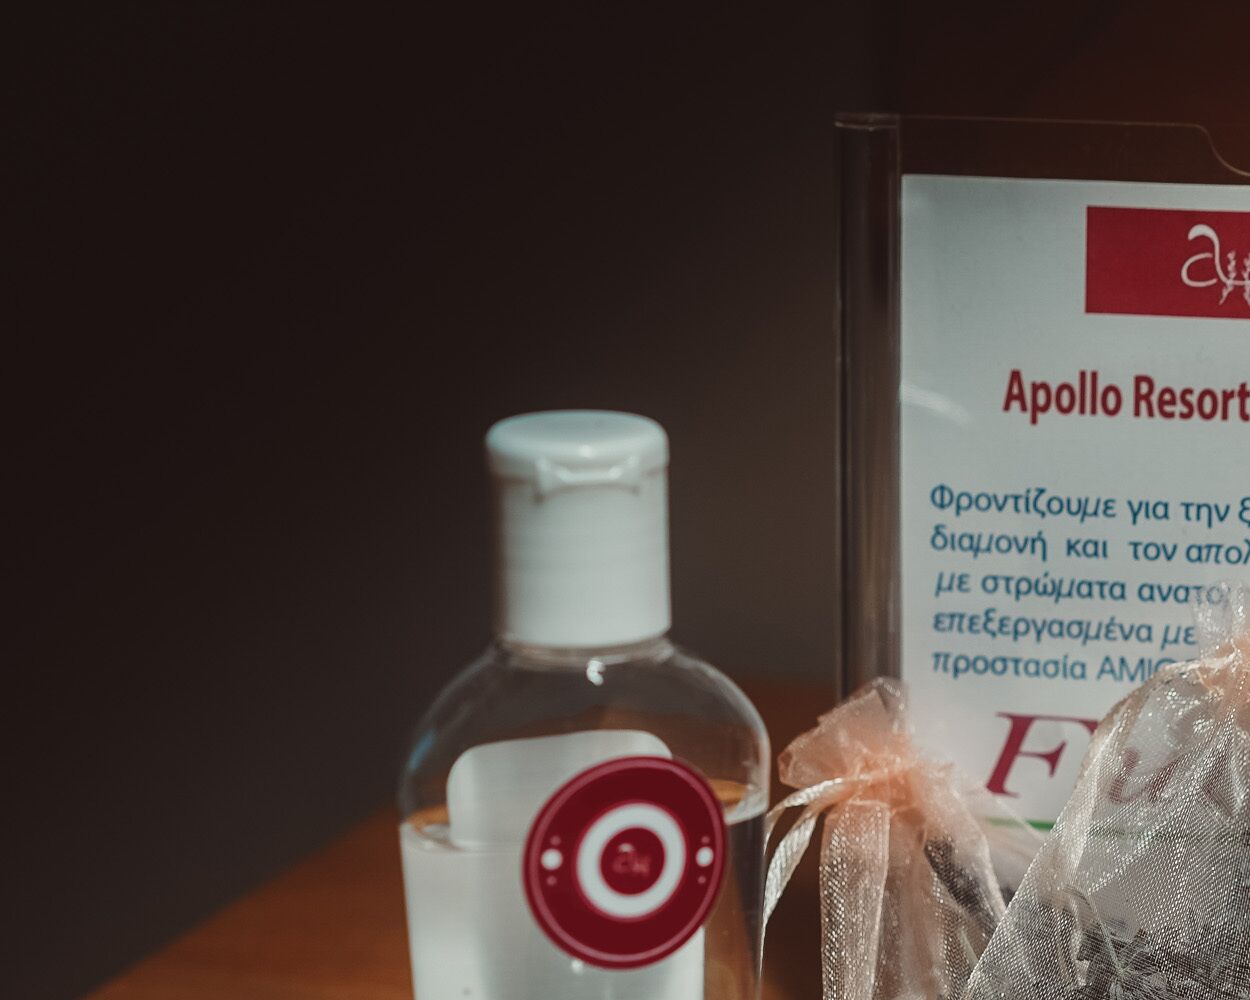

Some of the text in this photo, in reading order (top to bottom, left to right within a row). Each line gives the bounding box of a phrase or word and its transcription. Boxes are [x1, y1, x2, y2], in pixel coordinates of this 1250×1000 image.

[1002, 369, 1123, 426] Apollo
[930, 484, 1117, 523] Φροντίζουμε
[1127, 500, 1170, 526] για
[1180, 502, 1231, 529] την
[930, 523, 1048, 563] διαμονή
[1066, 538, 1108, 559] και
[1128, 541, 1178, 562] τον
[934, 571, 970, 598] με
[981, 571, 1127, 604] στρώματα
[932, 607, 1153, 646] επεξεργασμένα
[1160, 625, 1198, 651] με
[932, 650, 1087, 680] προστασία
